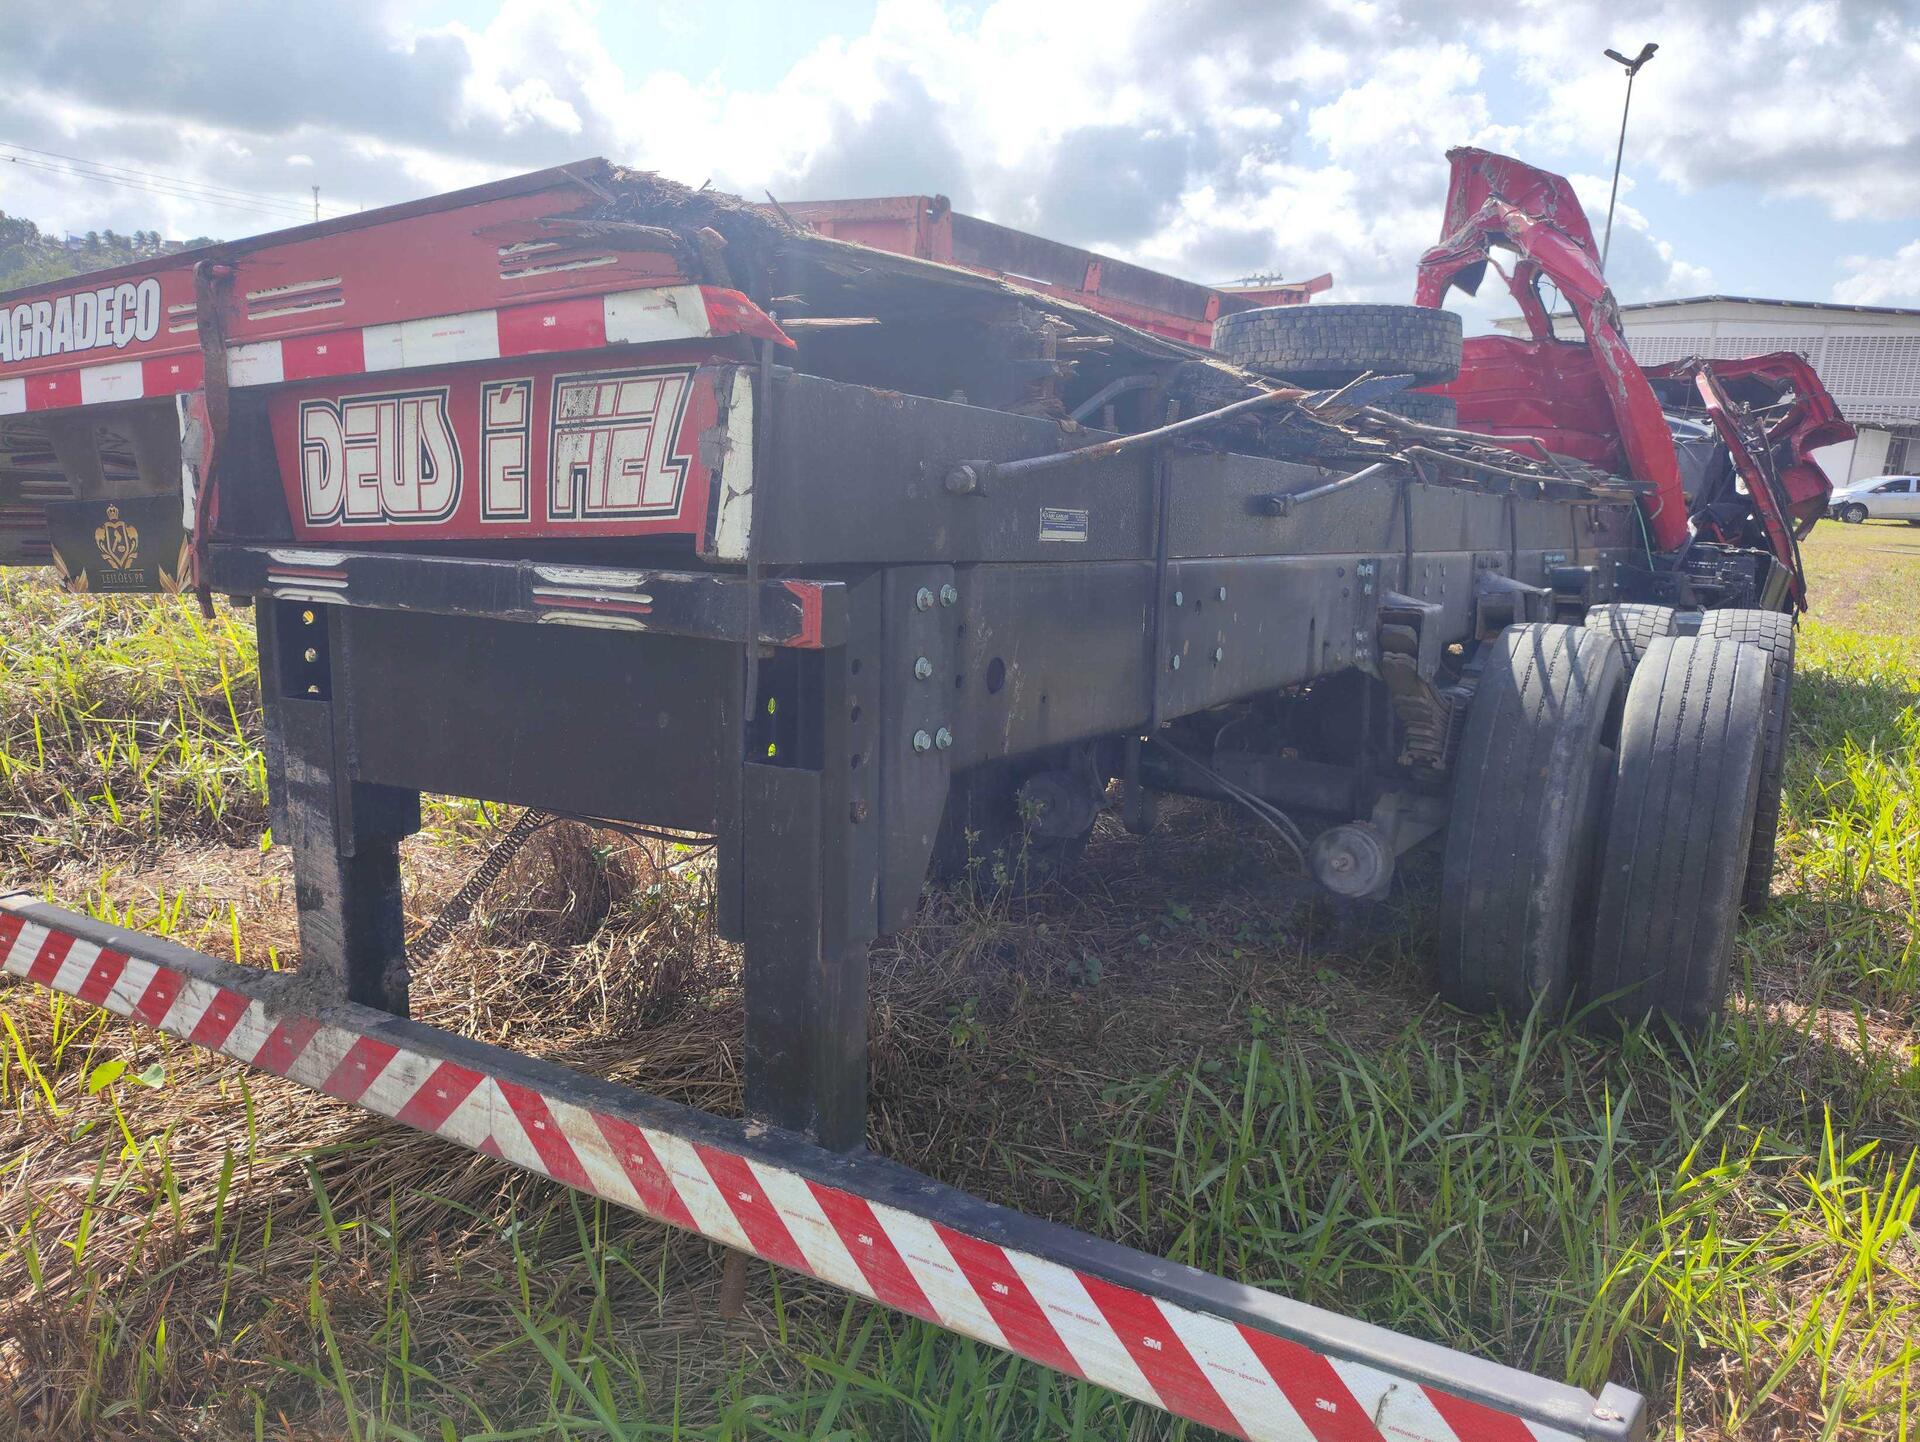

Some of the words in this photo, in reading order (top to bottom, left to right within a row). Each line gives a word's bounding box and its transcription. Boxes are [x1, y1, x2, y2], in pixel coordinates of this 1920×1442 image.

[543, 316, 556, 326] 3M
[317, 345, 327, 355] 3M
[300, 386, 463, 527] DEUS
[547, 363, 699, 523] FIEL
[533, 1119, 545, 1130] 3M
[738, 1191, 752, 1203] 3M
[858, 1233, 873, 1247] 3M
[992, 1281, 1008, 1296] 3M
[1143, 1336, 1162, 1351] 3M
[1315, 1397, 1337, 1414] 3M
